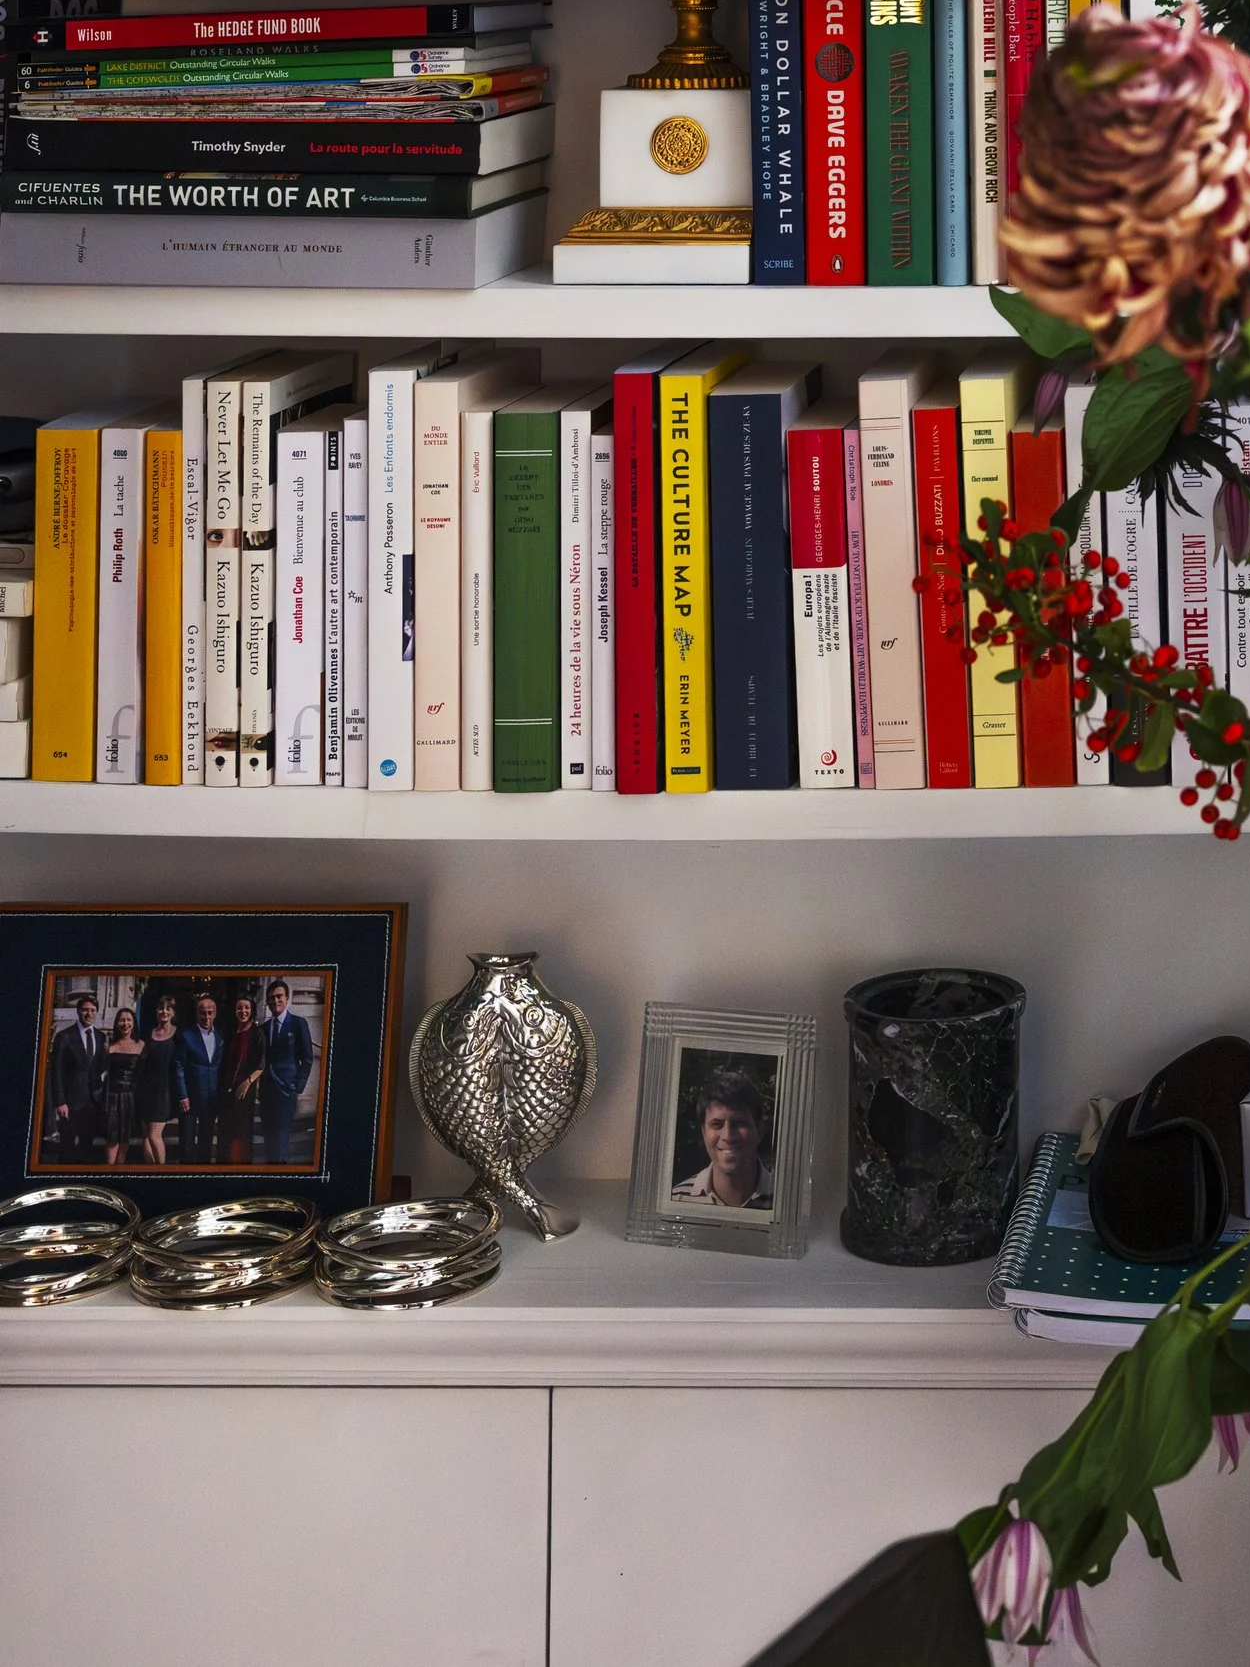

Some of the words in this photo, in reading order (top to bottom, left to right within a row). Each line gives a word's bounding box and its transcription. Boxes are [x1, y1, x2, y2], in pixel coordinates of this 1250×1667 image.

[78, 29, 111, 41] Wilson
[194, 22, 214, 38] The
[218, 21, 253, 37] HEDGE
[258, 19, 286, 35] FUND
[291, 18, 320, 33] BOOK
[827, 90, 845, 147] DAVE
[984, 90, 996, 119] THINK
[985, 123, 996, 143] AND
[192, 141, 238, 154] Timothy
[244, 141, 286, 154] Snyder
[985, 146, 997, 176] GROW
[113, 185, 161, 205] THE
[169, 186, 258, 207] WORTH
[267, 187, 299, 207] OF
[306, 188, 355, 208] ART
[828, 156, 846, 238] EGGERS
[986, 179, 998, 203] RICH
[218, 392, 231, 435] Never
[672, 393, 688, 439] THE
[218, 441, 230, 465] Let
[218, 470, 230, 492] Me
[812, 457, 820, 491] SOUTOU
[114, 476, 124, 501] tache
[672, 449, 690, 556] CULTURE
[114, 505, 123, 516] La
[218, 498, 230, 519] Go
[113, 528, 123, 551] Roth
[384, 503, 393, 548] Passeron
[113, 554, 125, 582] Philip
[384, 552, 395, 594] Anthony
[1182, 533, 1207, 602] L'OCCIDENT
[674, 566, 691, 617] MAP
